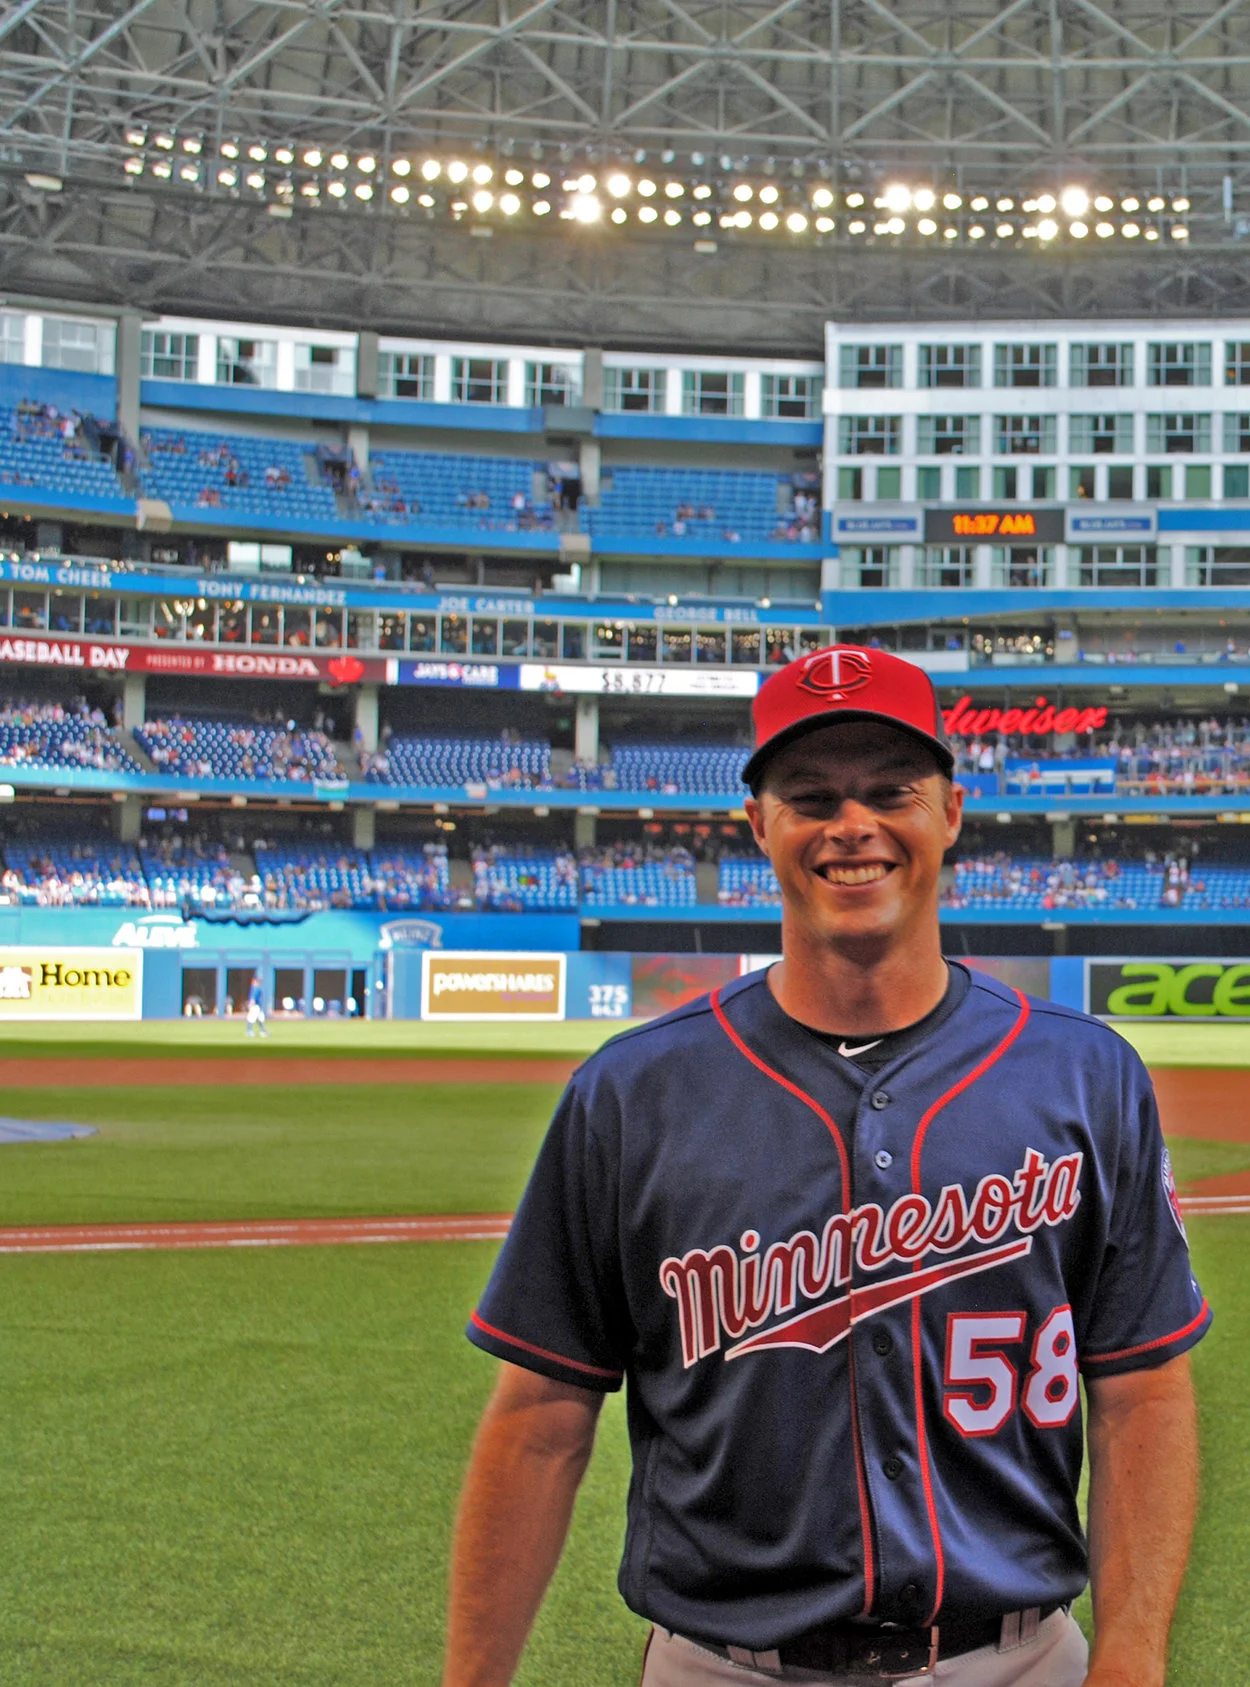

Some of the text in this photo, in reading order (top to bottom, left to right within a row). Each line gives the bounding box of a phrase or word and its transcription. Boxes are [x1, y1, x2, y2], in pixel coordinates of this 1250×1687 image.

[1000, 513, 1035, 535] AM
[11, 564, 49, 582] TOM
[56, 568, 112, 588] CHEEK
[196, 580, 347, 604] TONY FERNANDEZ
[437, 596, 535, 614] JOE CARTER
[653, 606, 758, 622] GEORGE BELL
[0, 638, 85, 666] ASEBALL
[89, 645, 130, 669] DAY
[212, 654, 320, 676] HONDA
[39, 963, 132, 987] Home
[588, 985, 629, 1005] 375
[660, 1147, 1083, 1368] Minnesota
[943, 1303, 1081, 1438] 58
